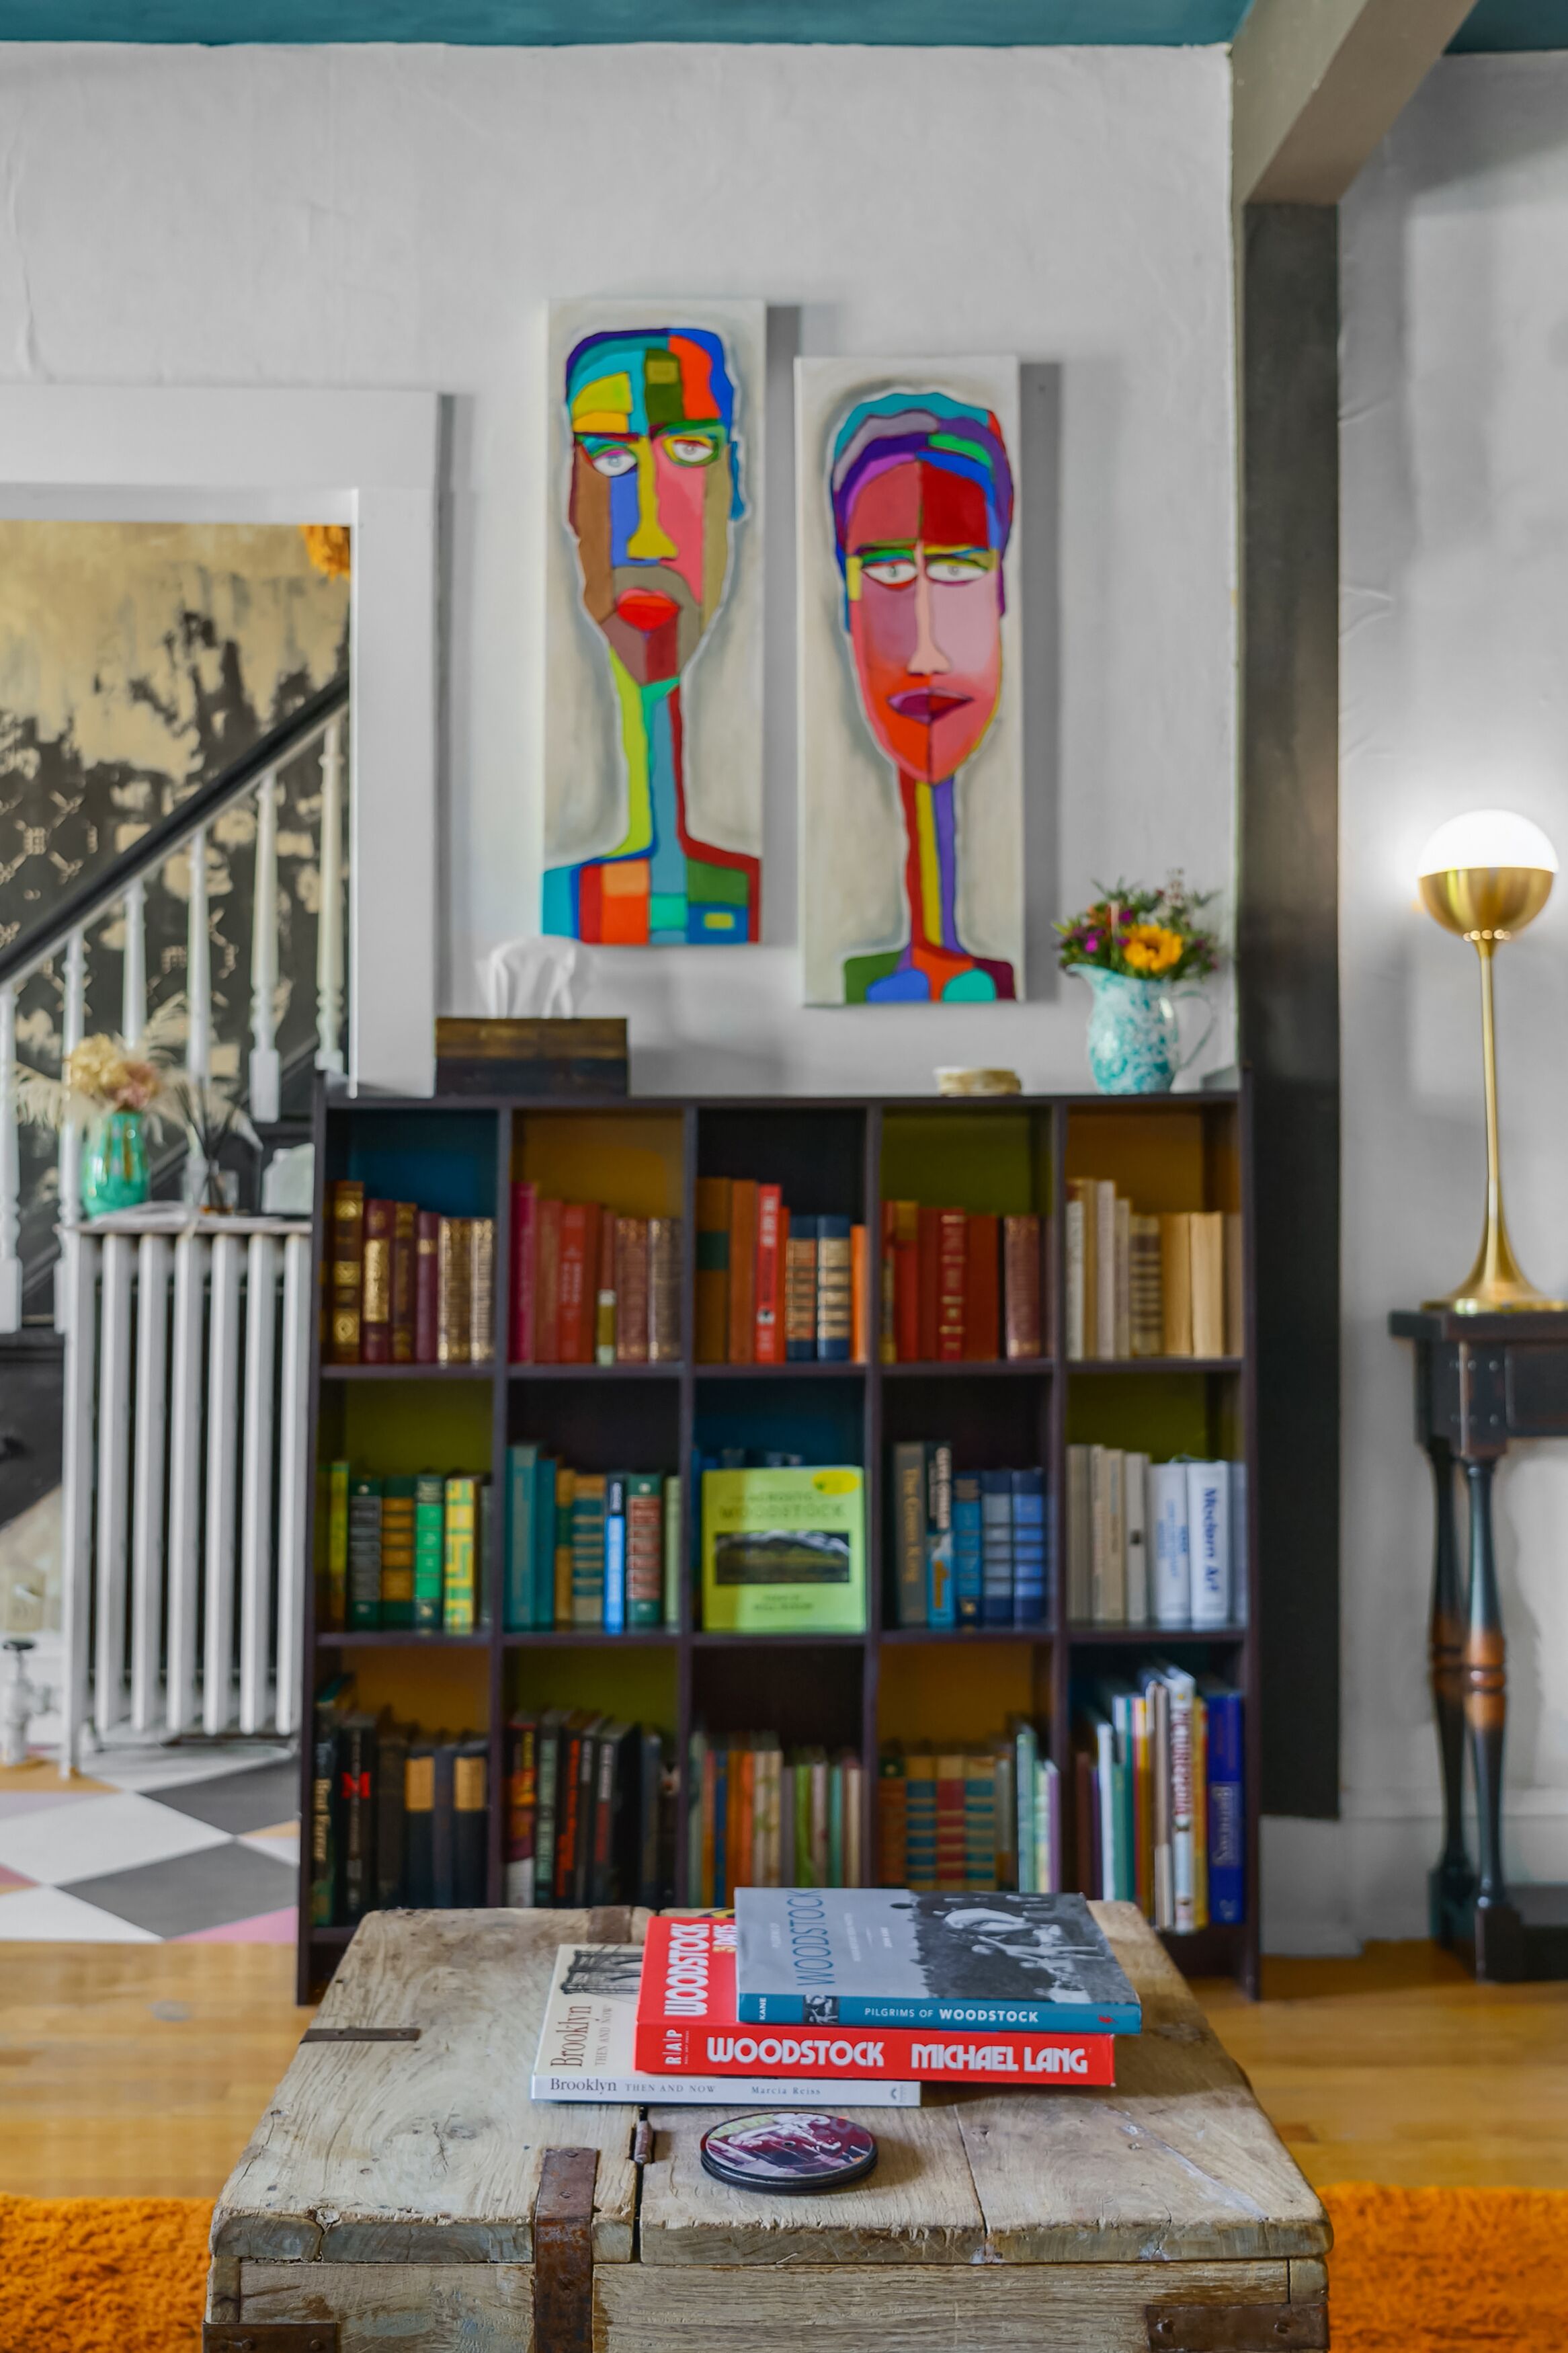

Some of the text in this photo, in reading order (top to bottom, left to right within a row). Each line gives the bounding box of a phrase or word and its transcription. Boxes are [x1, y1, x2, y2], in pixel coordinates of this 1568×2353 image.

[1204, 1488, 1220, 1591] Modern Art
[785, 1889, 836, 1987] WOODSTOCK
[663, 1923, 710, 2016] WOODSTOCK
[550, 2005, 600, 2067] Brooklyn
[595, 2006, 613, 2066] THEN AND NOW
[759, 1997, 768, 2020] KANE
[864, 2007, 1040, 2023] PILGRIMS OF WOODSTOCK
[706, 2036, 1089, 2074] WOODSTOCK MICHAEL LANG
[550, 2077, 821, 2096] Brooklyn THEN AND NOW Marcia Reiss
